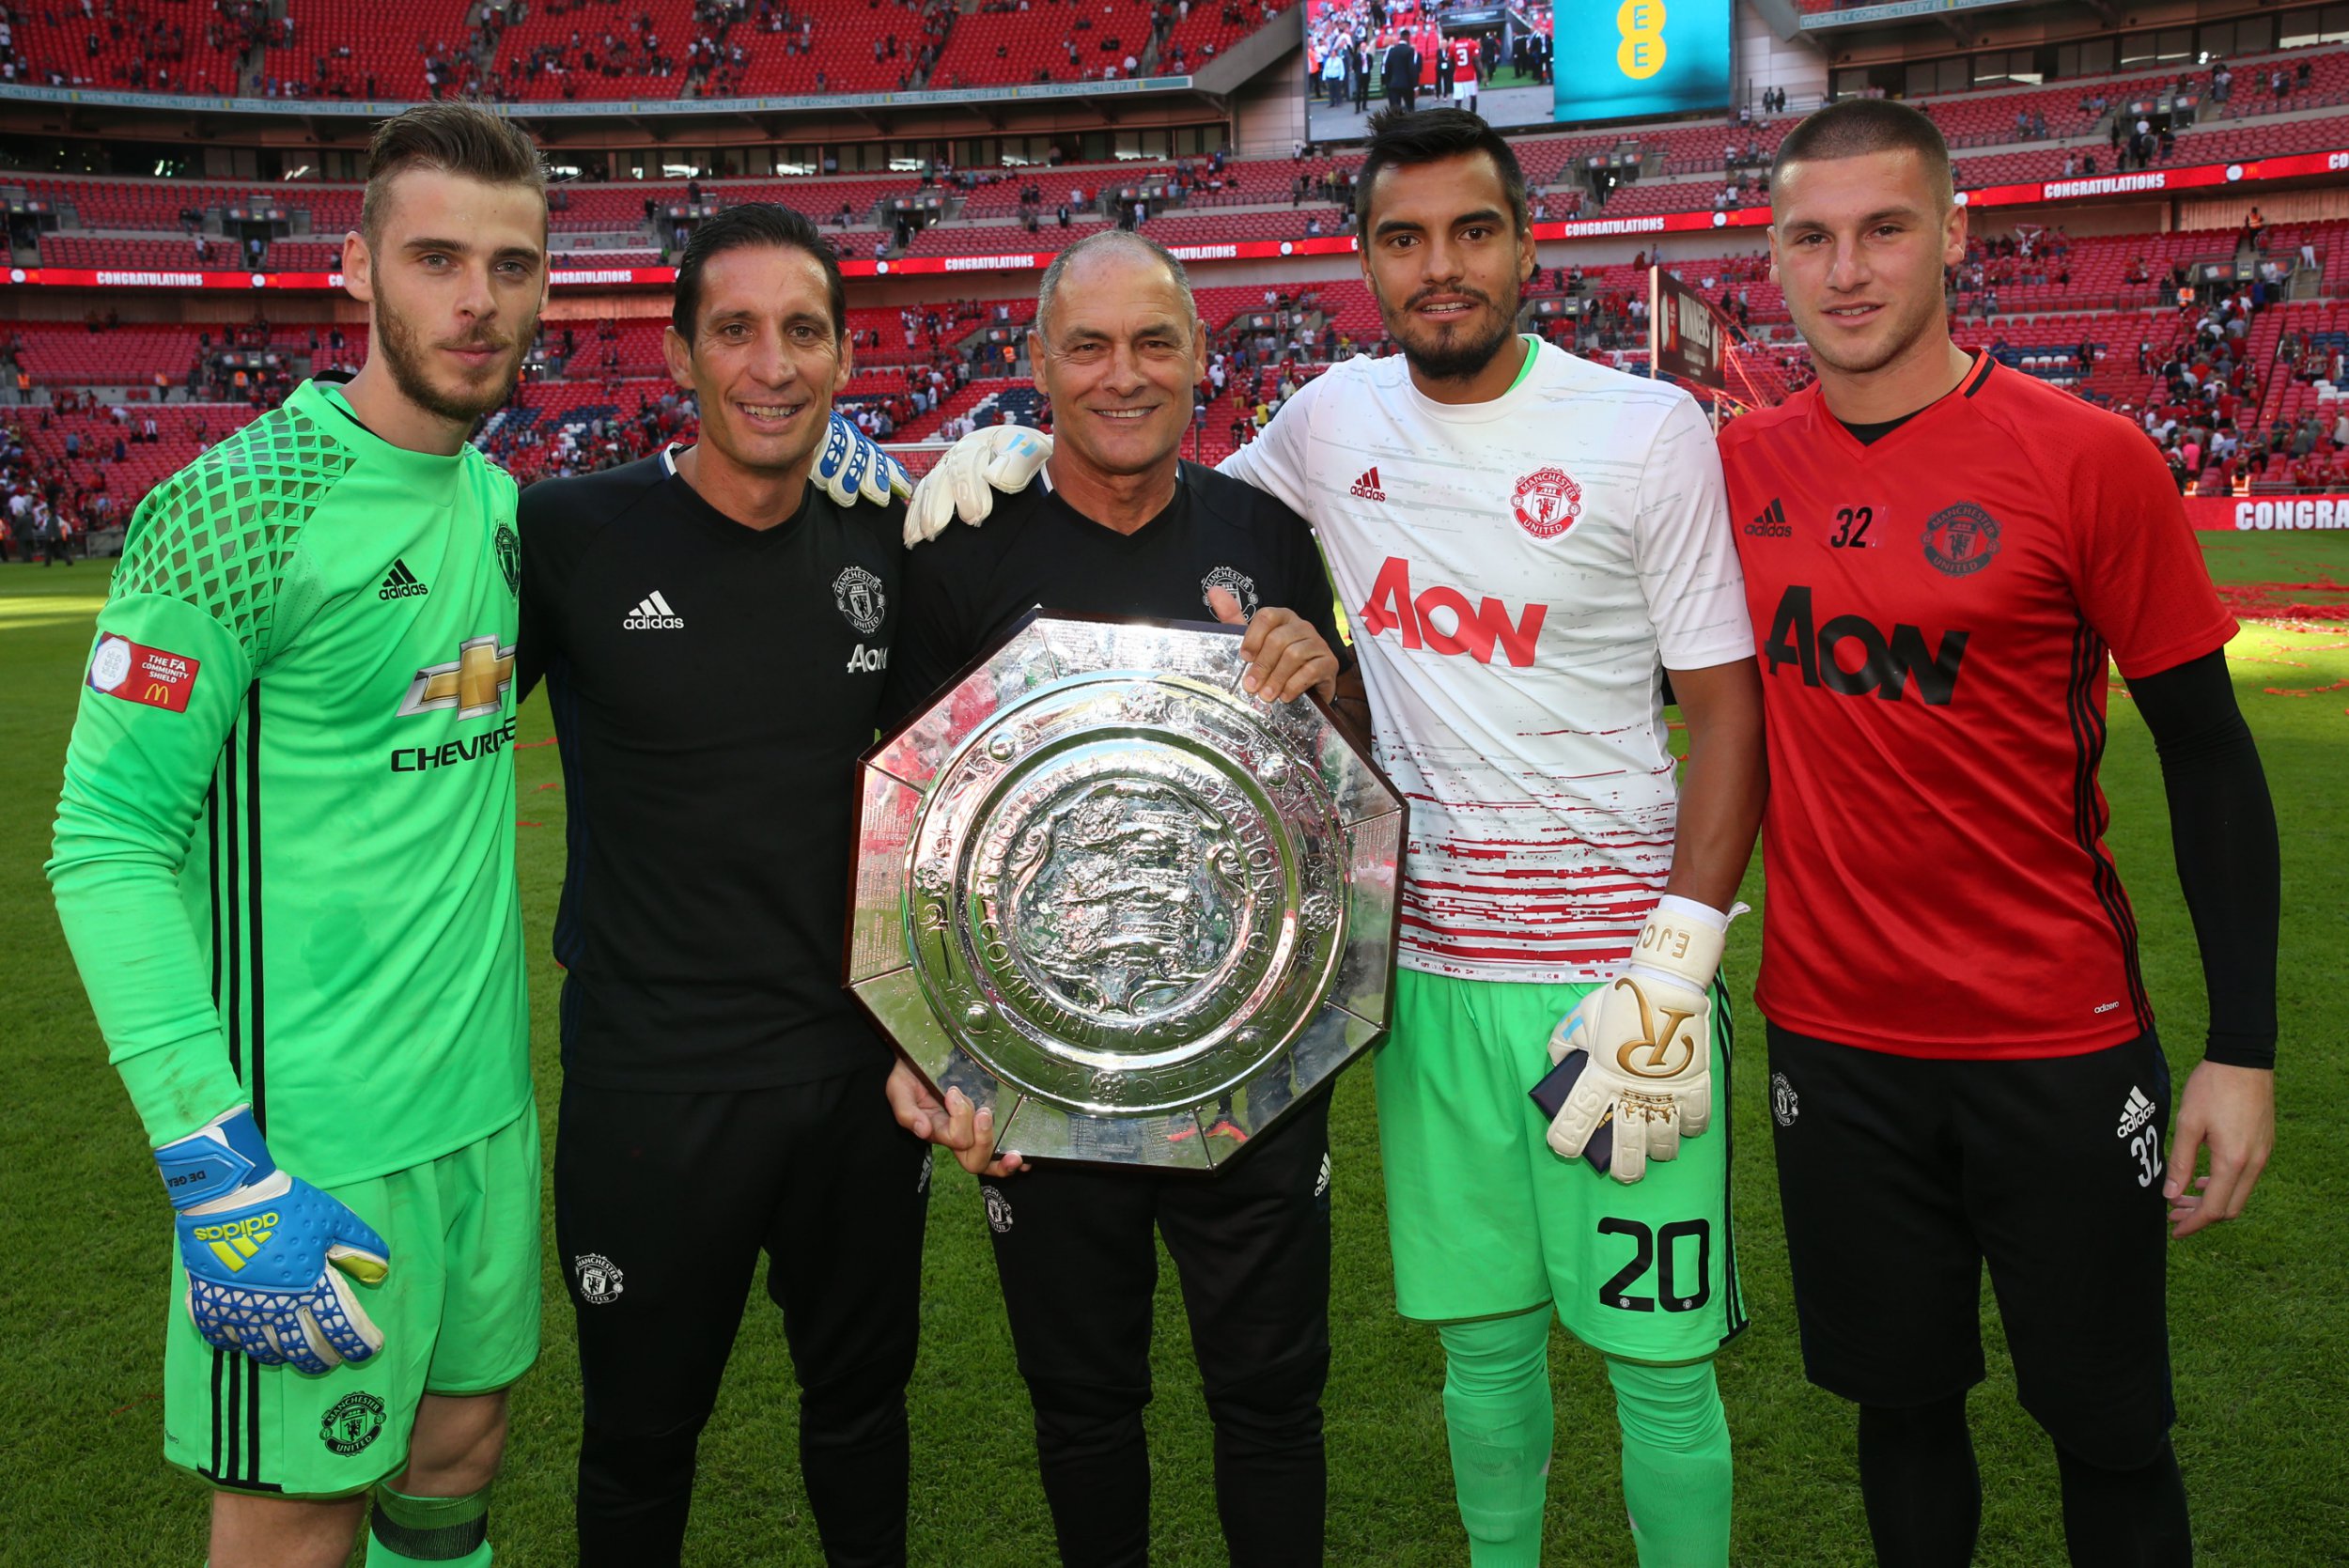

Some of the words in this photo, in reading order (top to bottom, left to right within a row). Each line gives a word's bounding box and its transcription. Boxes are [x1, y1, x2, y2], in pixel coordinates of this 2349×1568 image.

[1455, 48, 1469, 67] 3
[2043, 174, 2165, 198] CONGRATULATIONS
[1565, 217, 1664, 236] CONGRATULATIONS
[945, 255, 1034, 271] CONGRATULATIONS
[97, 272, 203, 287] CONGRATULATIONS
[1350, 484, 1386, 503] adidas
[1521, 473, 1576, 499] MANCHESTER
[1524, 519, 1562, 535] UNITED
[1744, 521, 1792, 538] adidas
[1830, 506, 1873, 549] 32
[1932, 506, 1995, 536] MANCHESTER
[1934, 556, 1978, 572] UNITED
[836, 570, 879, 595] MANCHESTER
[1206, 569, 1250, 590] MANCHESTER
[379, 582, 428, 601] adidas
[623, 615, 684, 629] adidas
[853, 615, 879, 629] UNITED
[142, 662, 189, 679] COMMUNITY
[148, 654, 169, 667] THE
[169, 659, 187, 672] FA
[148, 672, 178, 684] SHIELD
[2094, 1001, 2119, 1014] adizero
[2117, 1102, 2155, 1139] adidas
[2131, 1126, 2163, 1188] 32
[190, 1171, 207, 1183] DE
[194, 1212, 280, 1241] adidas
[577, 1258, 618, 1281] MANCHESTER
[1597, 1217, 1710, 1312] 20
[327, 1396, 381, 1422] MANCHESTER
[336, 1435, 373, 1452] UNITED
